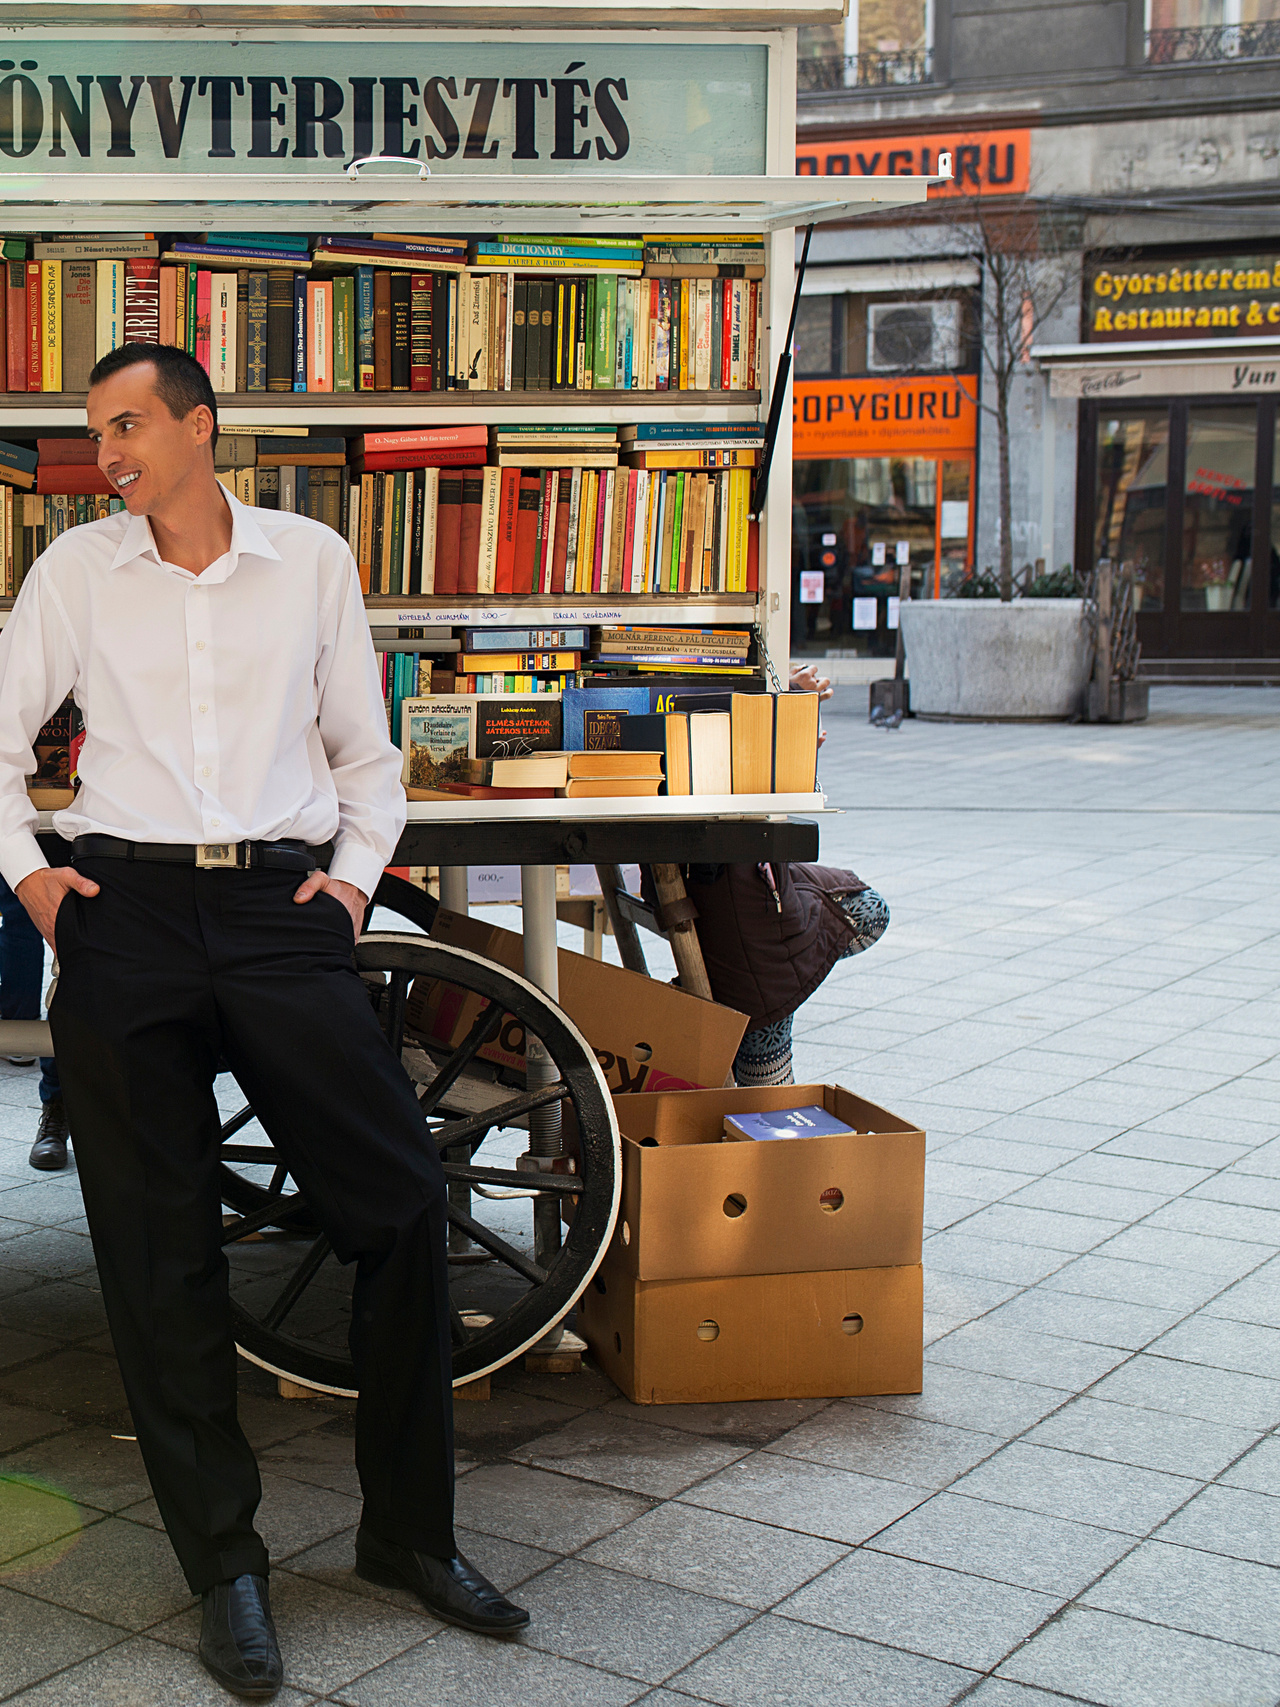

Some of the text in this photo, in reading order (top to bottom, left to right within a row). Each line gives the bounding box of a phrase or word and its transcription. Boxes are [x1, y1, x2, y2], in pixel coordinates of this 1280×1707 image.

[796, 143, 1014, 187] OPYGURU
[501, 243, 564, 256] DICTIONARY
[125, 276, 159, 345] ARLETT
[1094, 306, 1241, 332] Restaurant
[47, 335, 56, 348] DIE
[731, 333, 740, 362] SIMMEL
[793, 391, 961, 423] OPYGURU
[489, 470, 497, 486] FIAI
[488, 487, 497, 516] EMBER
[608, 631, 642, 641] MOLNÁR
[644, 632, 673, 643] FERENC
[486, 719, 515, 727] ELMÉS
[522, 727, 550, 735] ELMÉK
[478, 873, 504, 883] 600,-
